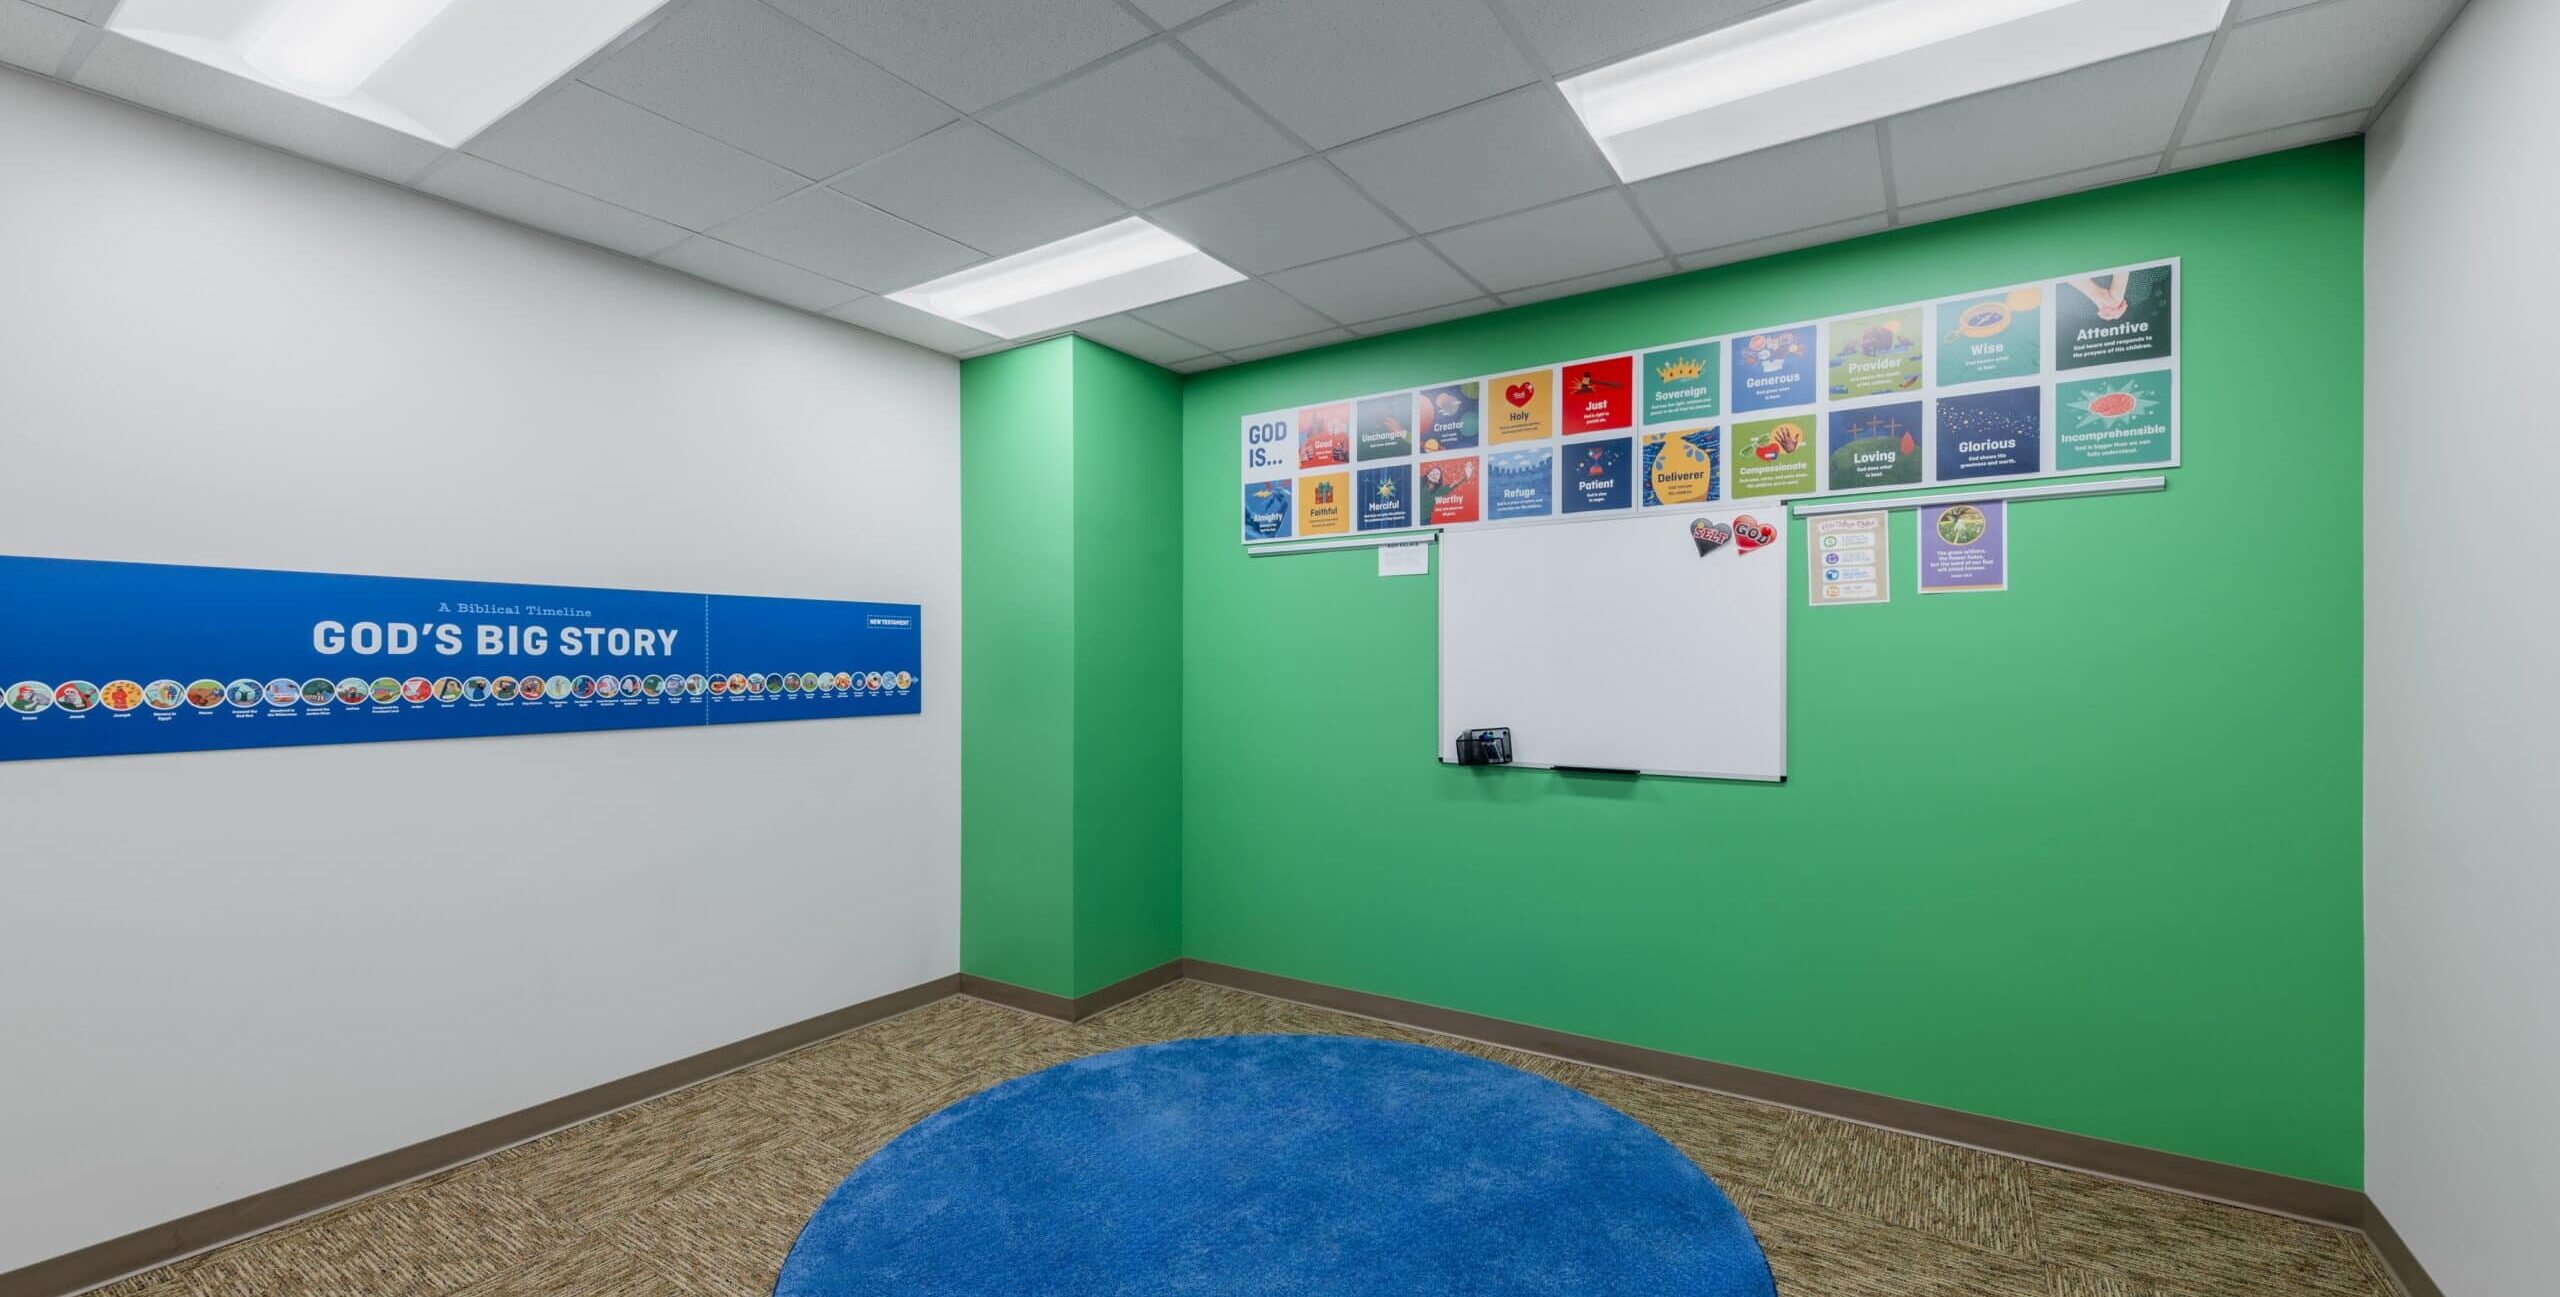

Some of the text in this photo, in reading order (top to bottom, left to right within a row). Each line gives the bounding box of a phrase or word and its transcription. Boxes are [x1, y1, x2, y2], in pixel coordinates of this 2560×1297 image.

[2077, 322, 2148, 341] Attentive
[1971, 342, 2003, 356] Wise
[1848, 358, 1901, 374] Provider
[1746, 373, 1800, 388] Generous
[1655, 386, 1707, 401] Sovereign
[1585, 399, 1607, 411] Just
[1510, 411, 1529, 421] Holy
[1249, 422, 1287, 445] GOD
[1433, 421, 1464, 432] Creator
[1362, 430, 1407, 443] Unchanging
[2061, 424, 2166, 444] Incomprehensible
[1315, 439, 1333, 449] Good
[1959, 438, 2016, 453] Glorious
[1249, 447, 1283, 468] IS...
[1854, 450, 1895, 464] Loving
[1740, 462, 1807, 476] Compassionate
[1658, 471, 1704, 483] Deliverer
[1579, 479, 1614, 491] Patient
[1503, 486, 1536, 499] Refuge
[1369, 500, 1400, 511] Merciful
[1434, 495, 1464, 505] Worthy
[1253, 512, 1283, 523] Almighty
[1310, 507, 1338, 517] Faithful
[1695, 527, 1728, 544] SELF
[437, 602, 592, 618] A Biblical Timeline
[313, 620, 679, 656] GOD'S BIG STORY
